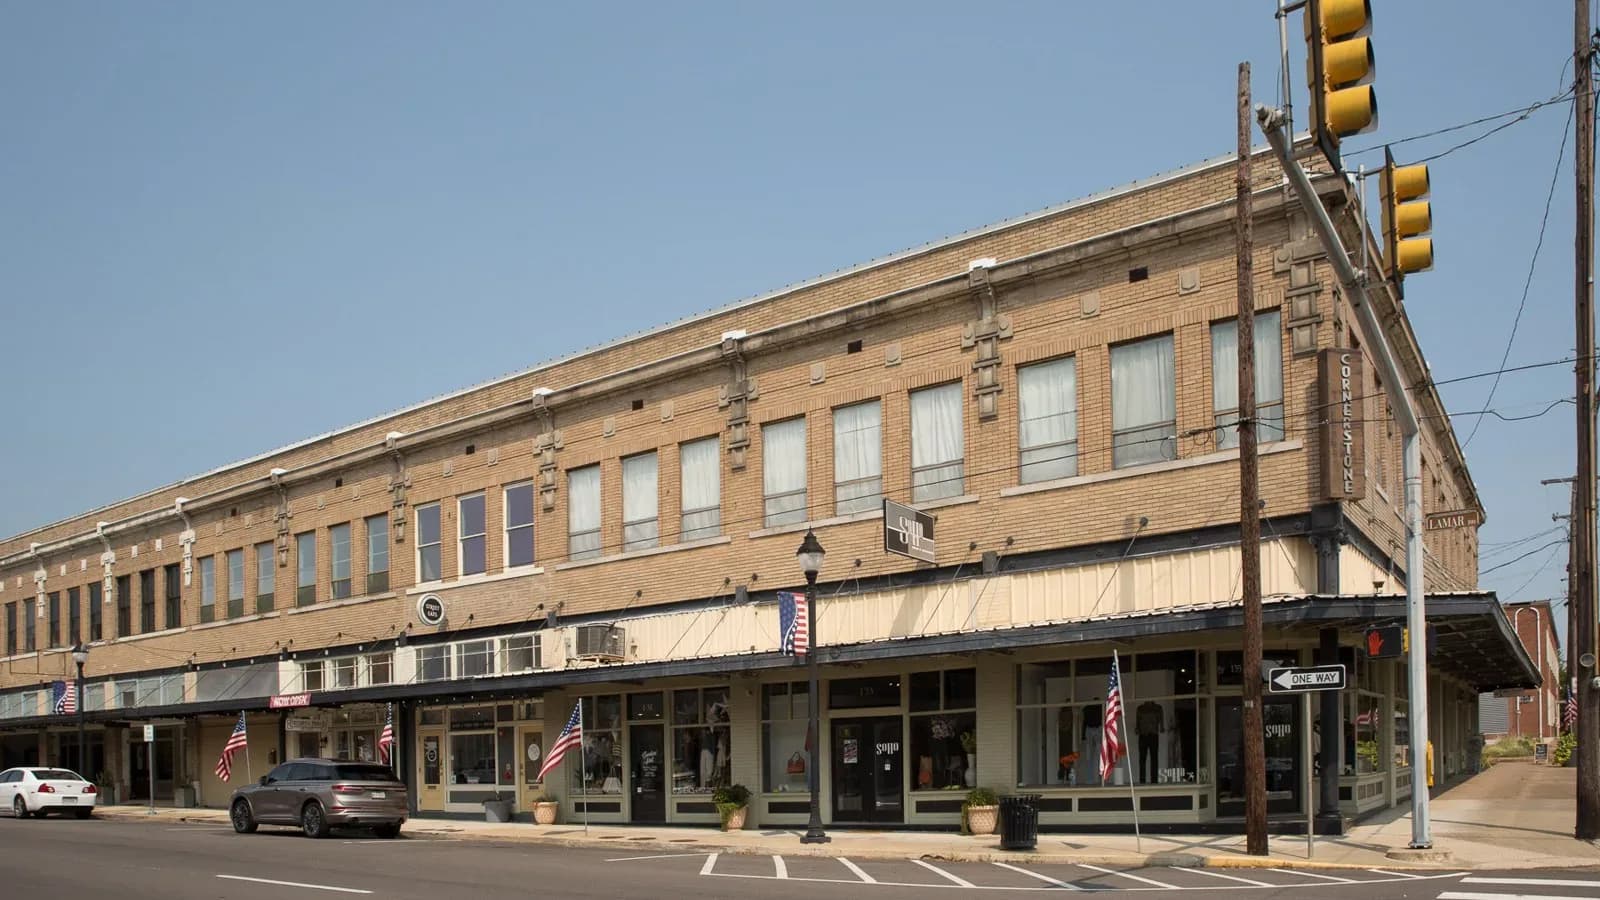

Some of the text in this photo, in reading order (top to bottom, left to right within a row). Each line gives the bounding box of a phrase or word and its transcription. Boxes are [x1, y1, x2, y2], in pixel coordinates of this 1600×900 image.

[1341, 354, 1353, 494] CORNERSTONE
[1429, 515, 1464, 530] LAMAR
[1292, 672, 1337, 684] ONE WAY
[274, 694, 307, 707] NOW OPEN
